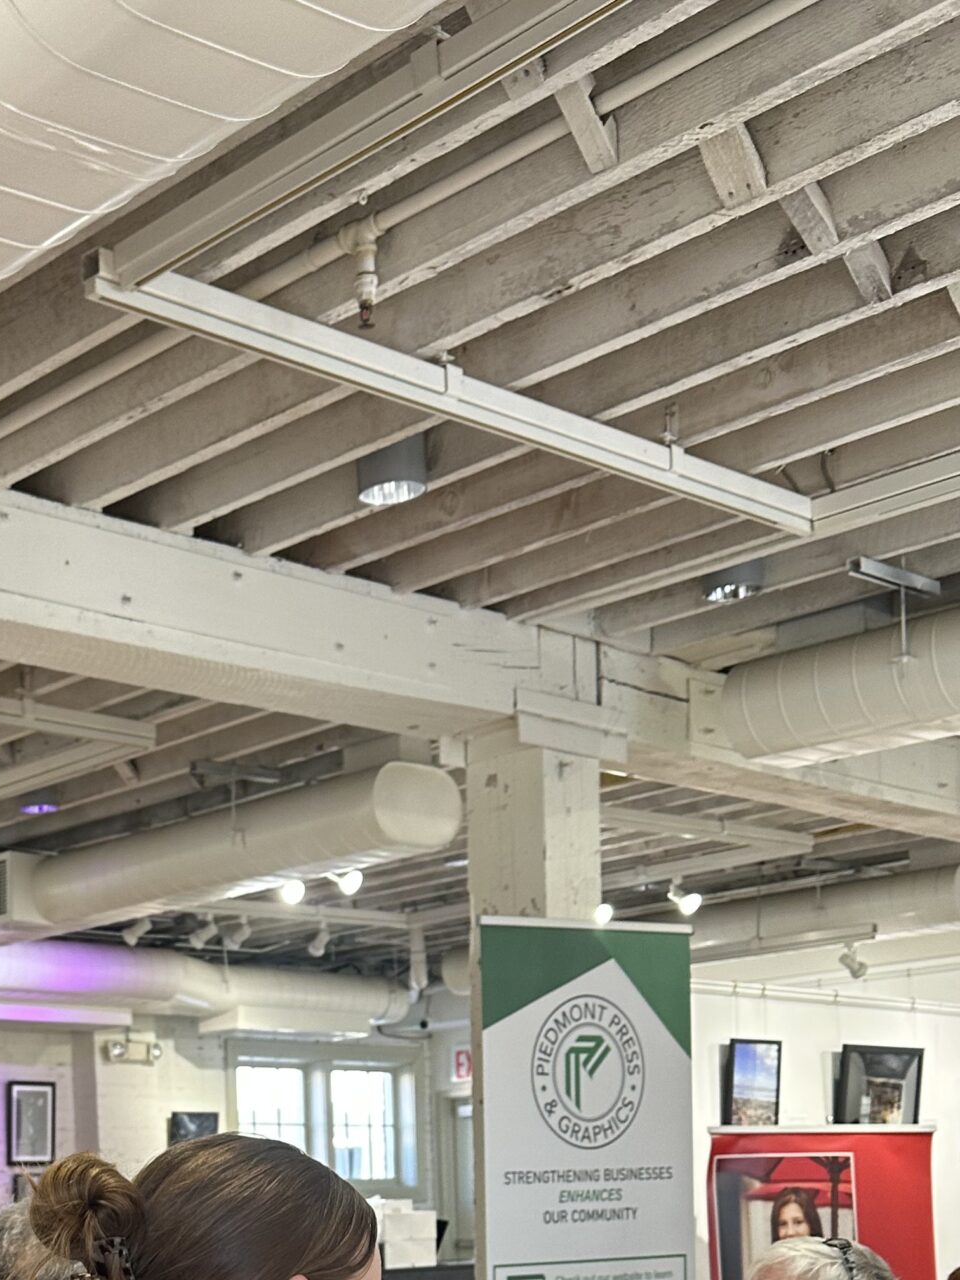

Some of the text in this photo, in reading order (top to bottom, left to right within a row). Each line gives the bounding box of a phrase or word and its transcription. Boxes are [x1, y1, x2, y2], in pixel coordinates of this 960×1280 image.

[536, 1002, 640, 1077] PIEDMONT PRESS
[544, 1096, 635, 1143] & GRAPHICS
[504, 1166, 673, 1185] STRENGTHENING BUSINESSES
[558, 1188, 623, 1203] ENHANCES
[543, 1207, 638, 1224] OUR COMMUNITY
